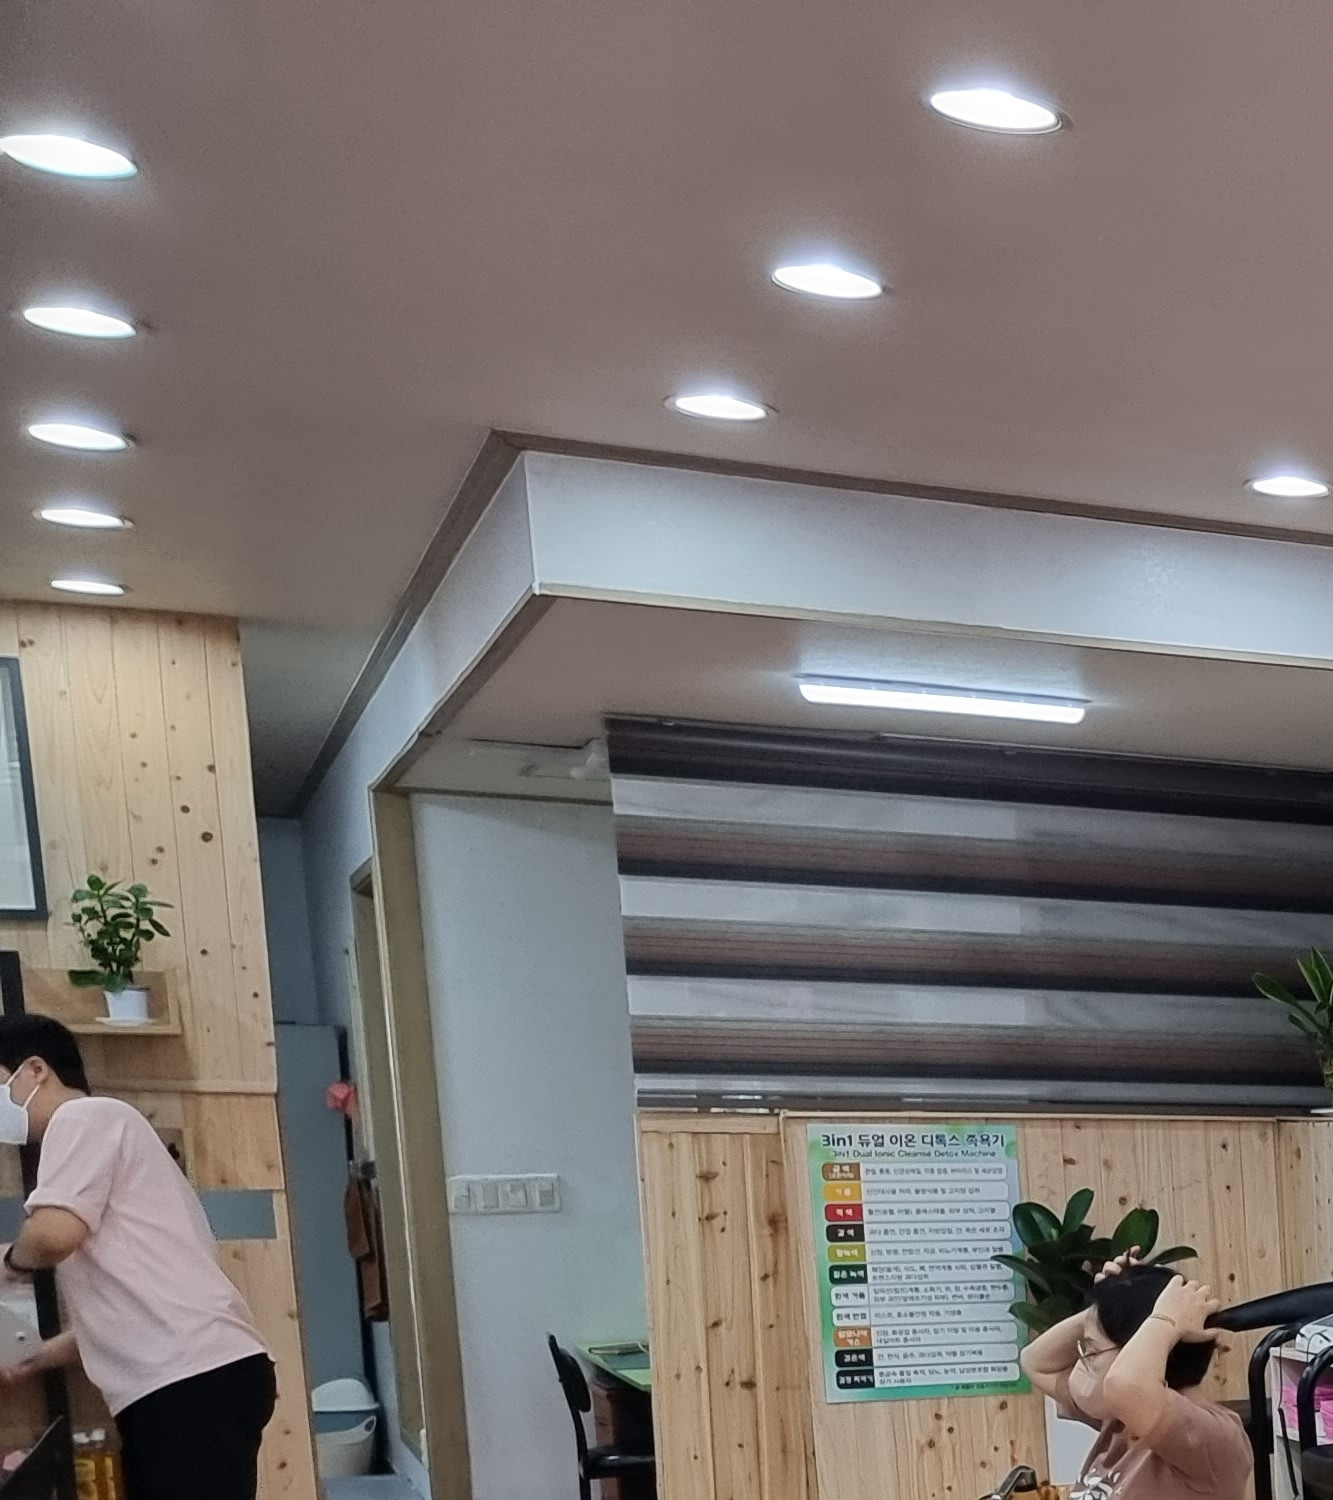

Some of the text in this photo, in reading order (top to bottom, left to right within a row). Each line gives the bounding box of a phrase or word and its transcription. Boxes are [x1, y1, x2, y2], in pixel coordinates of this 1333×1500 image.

[821, 1133, 853, 1148] 3in1
[889, 1133, 918, 1149] 이온
[921, 1133, 961, 1149] 디톡스
[966, 1133, 1005, 1149] 족욕기
[853, 1149, 873, 1158] Dual
